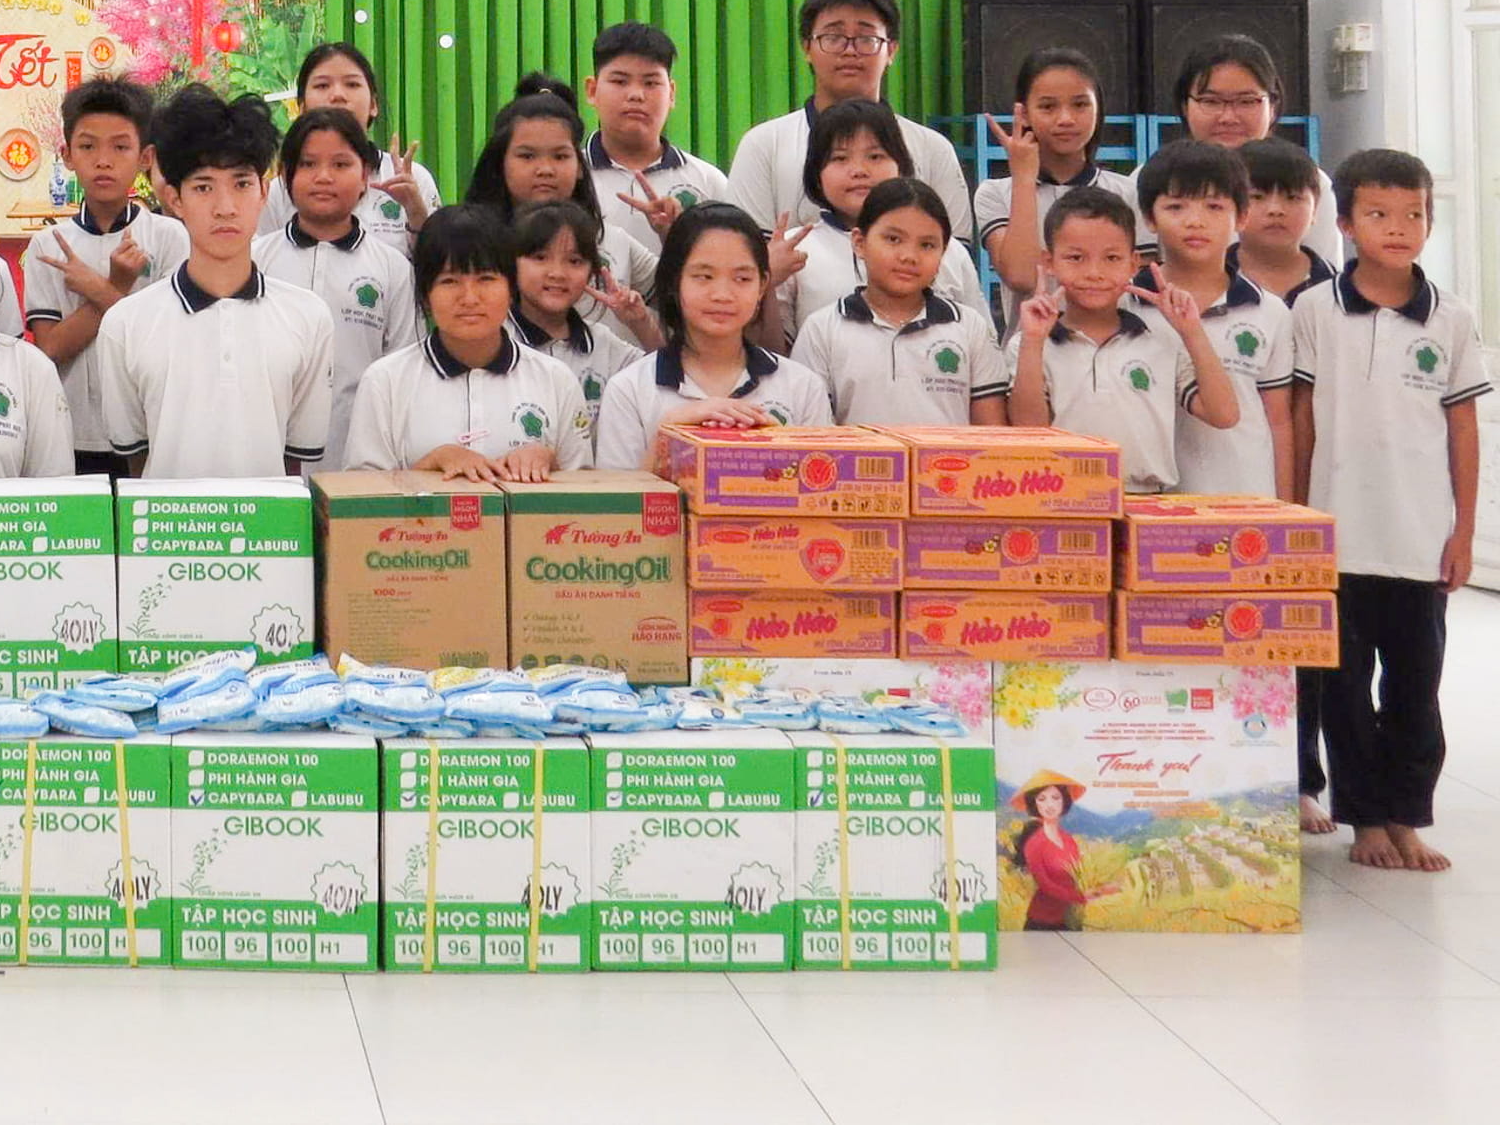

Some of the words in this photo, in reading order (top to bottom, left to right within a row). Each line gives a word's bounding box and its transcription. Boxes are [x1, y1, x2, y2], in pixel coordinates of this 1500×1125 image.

[973, 471, 1016, 500] Hảo
[1019, 467, 1064, 495] Hảo
[34, 502, 57, 513] 100
[151, 502, 227, 514] DORAEMON
[233, 503, 255, 514] 100
[22, 521, 47, 533] GIA
[152, 521, 173, 532] PHI
[178, 519, 216, 532] HÀNH
[220, 521, 245, 533] GIA
[51, 538, 100, 550] LABUBU
[152, 540, 224, 551] CAPYBARA
[249, 540, 298, 551] LABUBU
[366, 549, 470, 572] CookingOil
[526, 554, 671, 586] CookingOil
[746, 612, 790, 640] Hảo
[793, 606, 838, 635] Hảo
[960, 617, 1004, 645] Hảo
[1007, 611, 1052, 640] Hảo
[18, 649, 58, 662] SINH
[128, 646, 162, 669] TẬP
[87, 751, 111, 762] 100
[208, 753, 289, 765] DORAEMON
[295, 755, 318, 766] 100
[506, 755, 530, 767] 100
[626, 755, 706, 767] DORAEMON
[712, 755, 736, 766] 100
[912, 754, 936, 765] 100
[1096, 750, 1155, 776] Thank
[2, 769, 24, 780] PHI
[74, 770, 100, 782] GIA
[208, 773, 231, 784] PHI
[236, 771, 276, 785] HÀNH
[281, 774, 307, 786] GIA
[448, 772, 488, 787] HÀNH
[493, 775, 519, 787] GIA
[626, 774, 649, 786] PHI
[654, 772, 693, 786] HÀNH
[698, 775, 724, 787] GIA
[854, 771, 894, 785] HÀNH
[899, 774, 925, 786] GIA
[208, 793, 284, 805] CAPYBARA
[311, 794, 364, 806] LABUBU
[626, 794, 701, 806] CAPYBARA
[728, 794, 780, 806] LABUBU
[67, 905, 110, 919] SINH
[182, 903, 216, 927] TẬP
[223, 908, 266, 929] HỌC
[273, 910, 316, 925] SINH
[599, 906, 633, 930] TẬP
[640, 909, 683, 930] HỌC
[690, 911, 733, 925] SINH
[893, 909, 936, 924] SINH
[436, 911, 479, 931] HỌC
[486, 912, 529, 926] SINH
[70, 933, 101, 948] 100
[186, 937, 218, 951] 100
[234, 937, 257, 953] 96
[276, 939, 308, 953] 100
[448, 940, 470, 956] 96
[489, 940, 520, 955] 100
[603, 939, 635, 953] 100
[652, 939, 674, 955] 96
[693, 939, 724, 954] 100
[807, 938, 839, 951] 100
[855, 937, 877, 953] 96
[896, 938, 927, 952] 100
